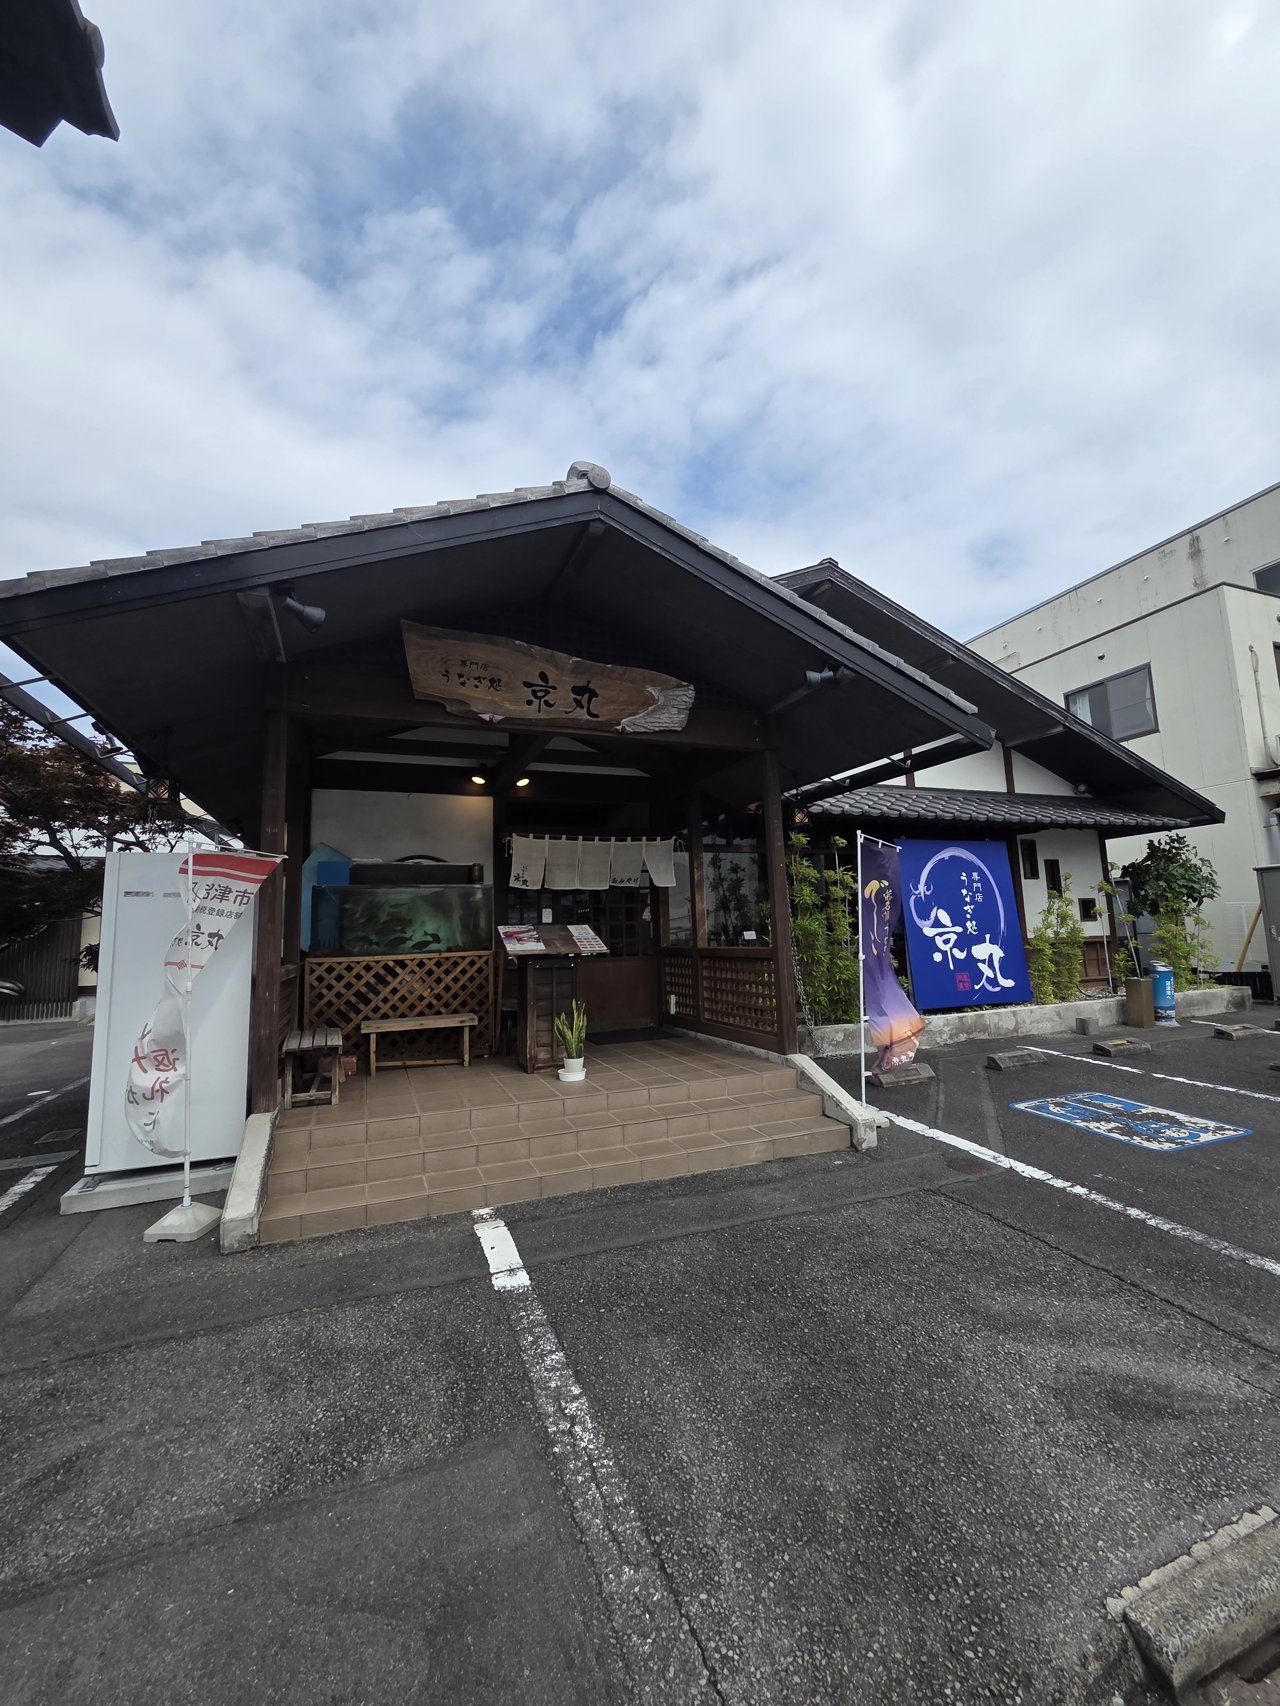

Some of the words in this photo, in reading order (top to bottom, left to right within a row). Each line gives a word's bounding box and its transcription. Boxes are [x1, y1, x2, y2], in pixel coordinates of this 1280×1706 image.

[441, 669, 503, 692] うなぎ処
[522, 670, 600, 719] 京丸
[959, 871, 979, 936] うなぎ処
[971, 871, 984, 903] 専門店
[922, 908, 1016, 990] 京丸
